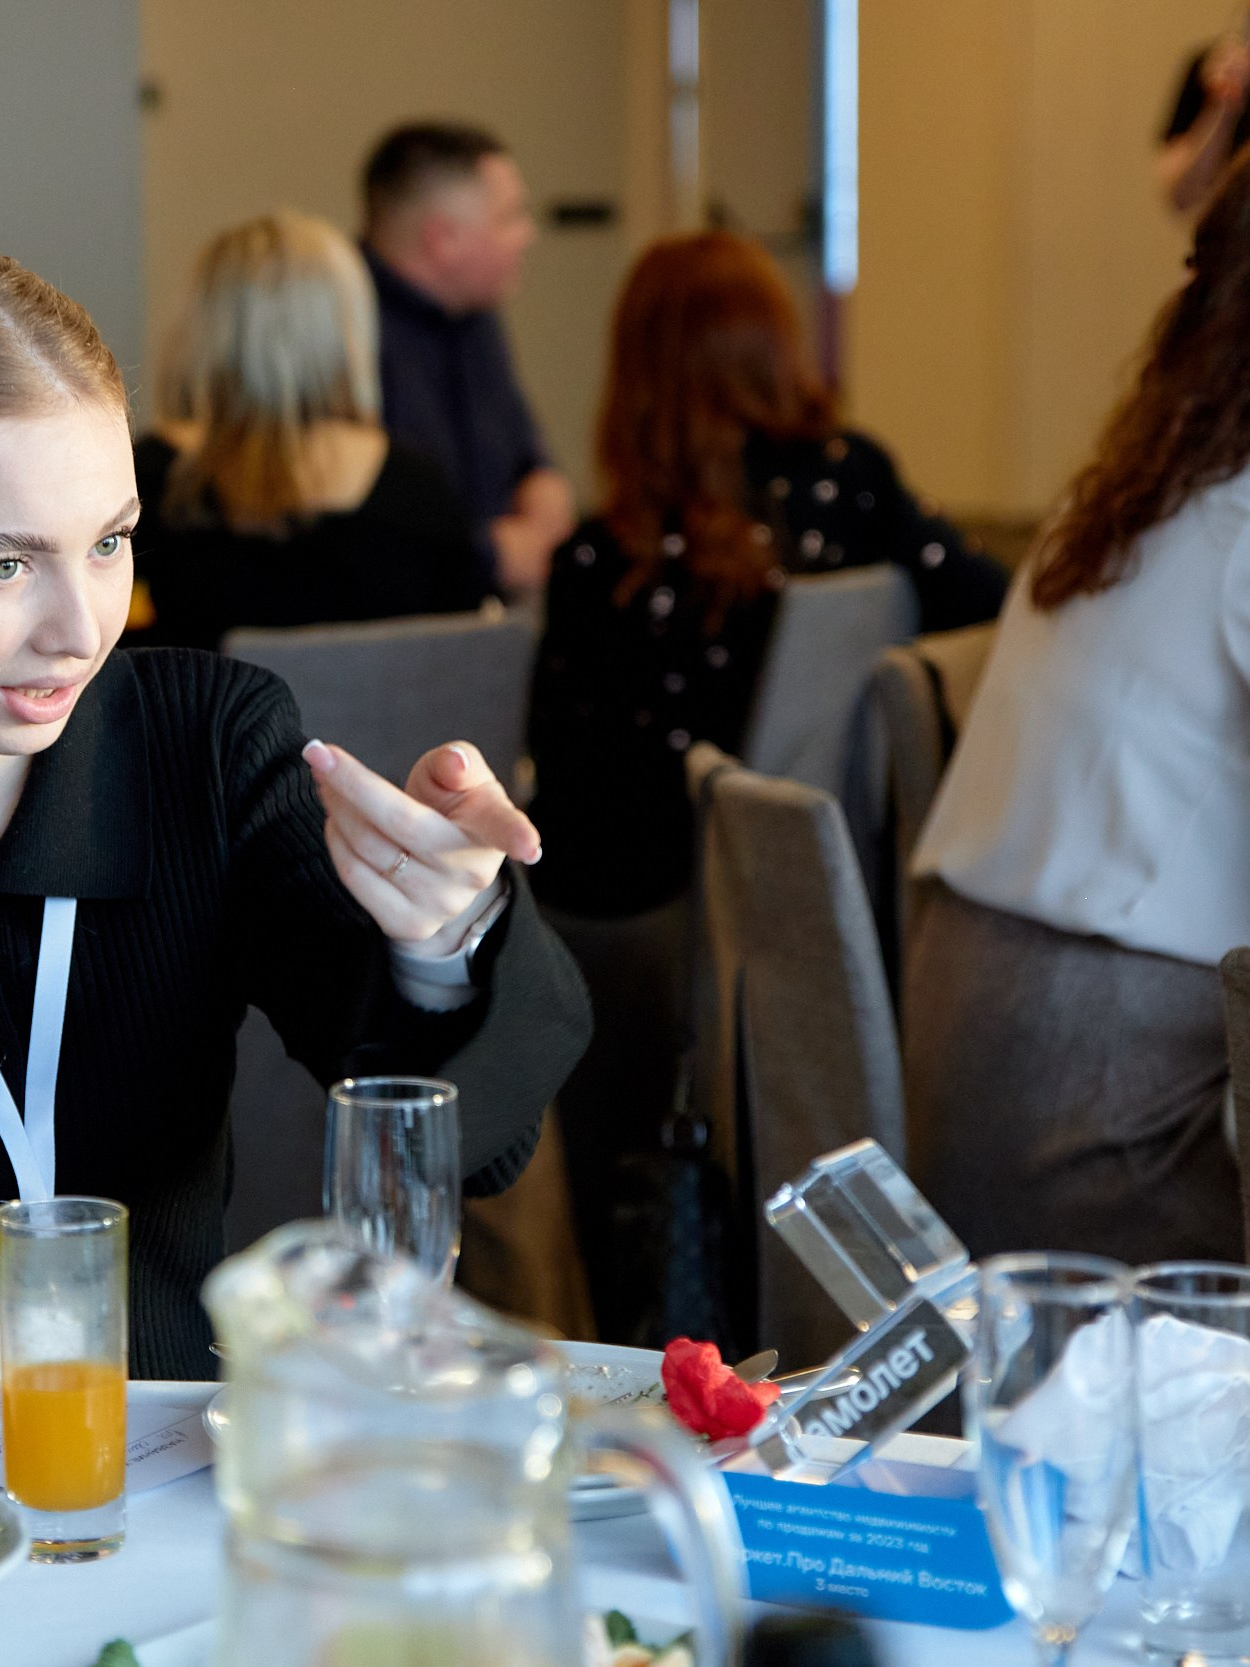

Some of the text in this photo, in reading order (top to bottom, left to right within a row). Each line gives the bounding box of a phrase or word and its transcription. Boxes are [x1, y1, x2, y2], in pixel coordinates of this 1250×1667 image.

[803, 1329, 936, 1438] амолет
[757, 1518, 930, 1555] по продажам за 2023 год
[740, 1549, 988, 1597] ркет.Про Дальний Восток
[814, 1577, 870, 1599] 3 место
